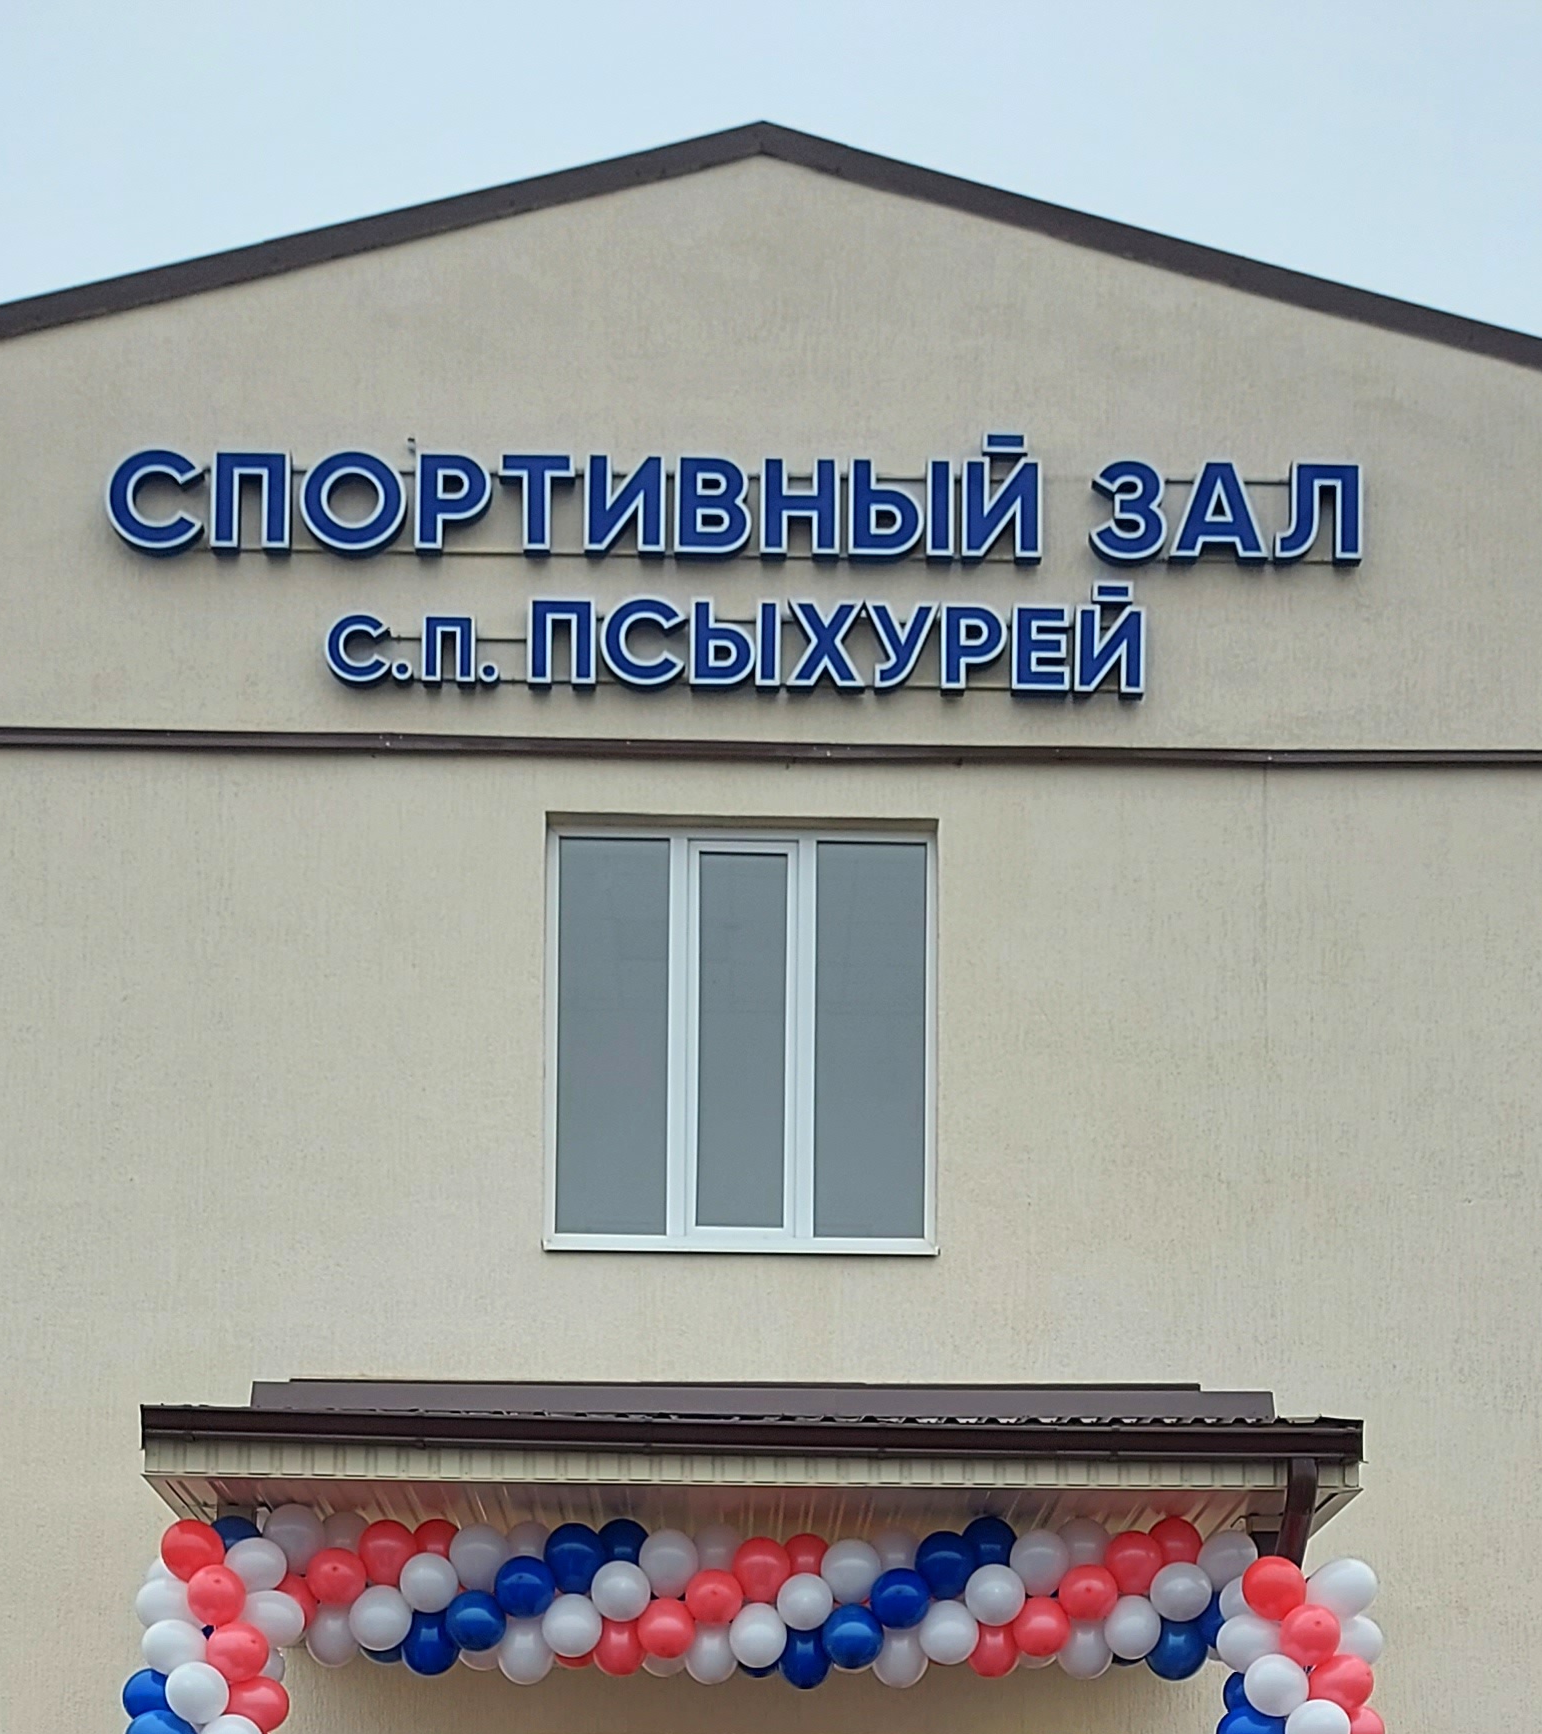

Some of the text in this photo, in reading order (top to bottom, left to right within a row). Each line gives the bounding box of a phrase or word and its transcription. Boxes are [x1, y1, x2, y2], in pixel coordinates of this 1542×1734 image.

[106, 433, 1362, 565] СПОРТИВНЫЙ ЗАЛ
[525, 580, 1147, 697] ПСЫХУРЕЙ
